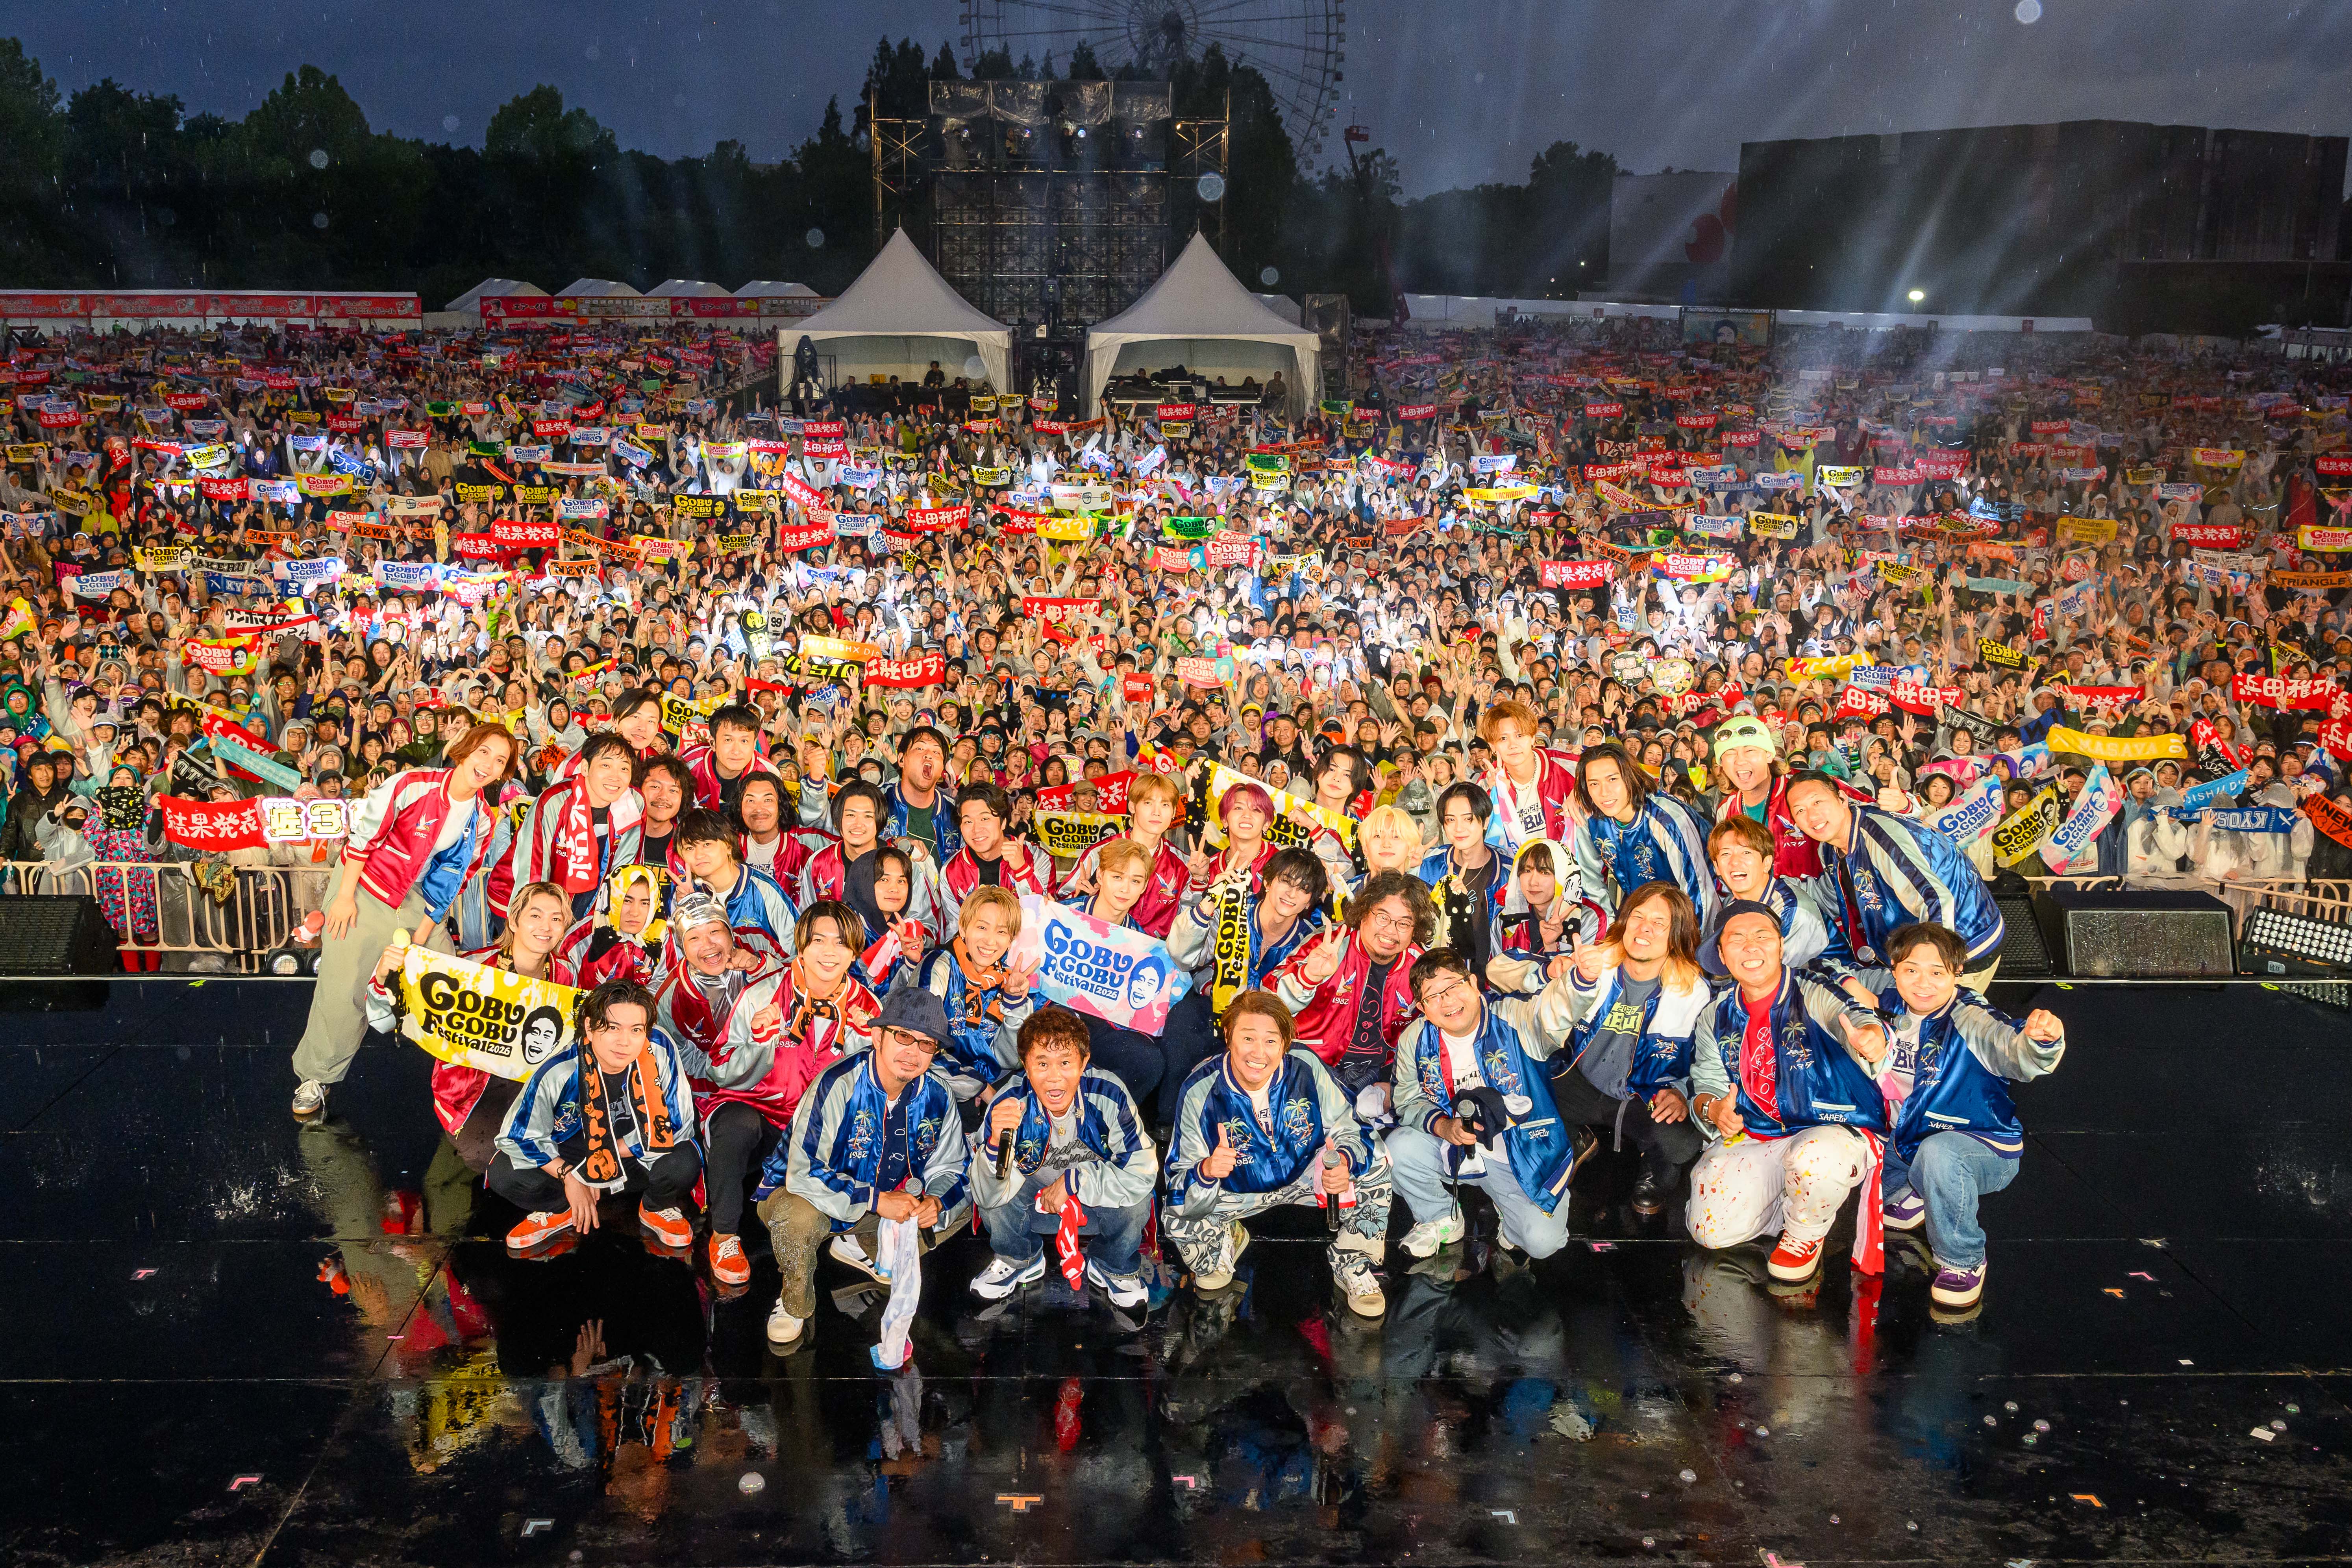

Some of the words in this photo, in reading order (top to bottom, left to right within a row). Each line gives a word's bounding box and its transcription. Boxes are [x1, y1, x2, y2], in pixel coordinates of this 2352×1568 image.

[513, 303, 547, 311] エアーくじ
[1159, 407, 1193, 416] 結果発表!
[1400, 407, 1434, 419] 浜田雅功
[1587, 404, 1623, 414] 結果発表!
[805, 423, 842, 433] 結果発表!
[1500, 431, 1534, 443] TRIANGLE
[750, 438, 789, 450] 結果発表!
[803, 442, 843, 453] 浜田雅功
[193, 451, 217, 460] GOBU
[1585, 465, 1632, 479] 浜田雅功
[1875, 467, 1924, 481] 結果発表!
[307, 476, 333, 485] GOBU
[257, 484, 282, 493] GOBU
[455, 483, 491, 494] GOBU
[783, 477, 825, 508] 結果発表!
[1495, 489, 1526, 500] TACHIBANA
[674, 495, 712, 507] GOBU
[335, 511, 366, 520] GOBU
[835, 515, 865, 523] GOBU
[912, 508, 968, 526] 浜田雅功
[1693, 516, 1723, 525] GOBU
[1754, 515, 1784, 525] GOBU
[1173, 519, 1204, 528] GOBU
[495, 525, 561, 541] 結果発表!
[718, 534, 750, 544] GOBU
[2175, 526, 2237, 541] 結果発表!
[2310, 530, 2344, 539] GOBU
[141, 547, 179, 558] GOBU
[1158, 548, 1190, 557] GOBU
[1208, 542, 1251, 554] GOBU
[287, 559, 323, 570] GOBU
[1166, 556, 1188, 565] GOBU
[1666, 554, 1705, 565] GOBU
[56, 561, 83, 575] NEWS
[555, 563, 596, 576] NEWS
[76, 574, 115, 583] GOBU
[2280, 577, 2347, 587] TRIANGLE
[226, 579, 281, 594] KYSUKE
[771, 617, 782, 627] 99
[186, 642, 231, 657] GOBU
[1982, 645, 2023, 659] GOBU
[1179, 657, 1216, 670] GOBU
[1615, 657, 1636, 669] 結果
[1185, 668, 1216, 677] GOBU
[1622, 667, 1645, 679] 発表
[1853, 672, 1882, 685] Festival
[2239, 672, 2336, 698] 浜田雅功
[2078, 737, 2158, 758] MASAYA
[172, 759, 214, 793] OTO
[1937, 796, 1987, 833] GOBU
[1959, 805, 1990, 831] GOBU
[1044, 819, 1099, 835] GOBU
[1993, 810, 2040, 847] GOBU
[2053, 803, 2091, 846] GOBU
[2072, 809, 2095, 840] GOBU
[1950, 823, 1984, 842] Festival
[2014, 820, 2045, 844] GOBU
[1049, 837, 1084, 849] Festival
[1062, 834, 1097, 844] GOBU
[2067, 826, 2092, 852] Festival
[2001, 835, 2039, 857] Festival
[1219, 888, 1240, 959] GOBU
[1044, 919, 1133, 972] GOBU
[1220, 913, 1250, 989] Festival
[1040, 952, 1095, 992] Festival
[1096, 986, 1119, 1000] 2026
[1060, 956, 1125, 987] GOBU
[420, 972, 525, 1025] GOBU
[422, 1009, 487, 1051] Festival
[487, 1042, 512, 1057] 2026
[446, 1012, 517, 1043] GOBU
[1789, 1060, 1814, 1071] ハマダ
